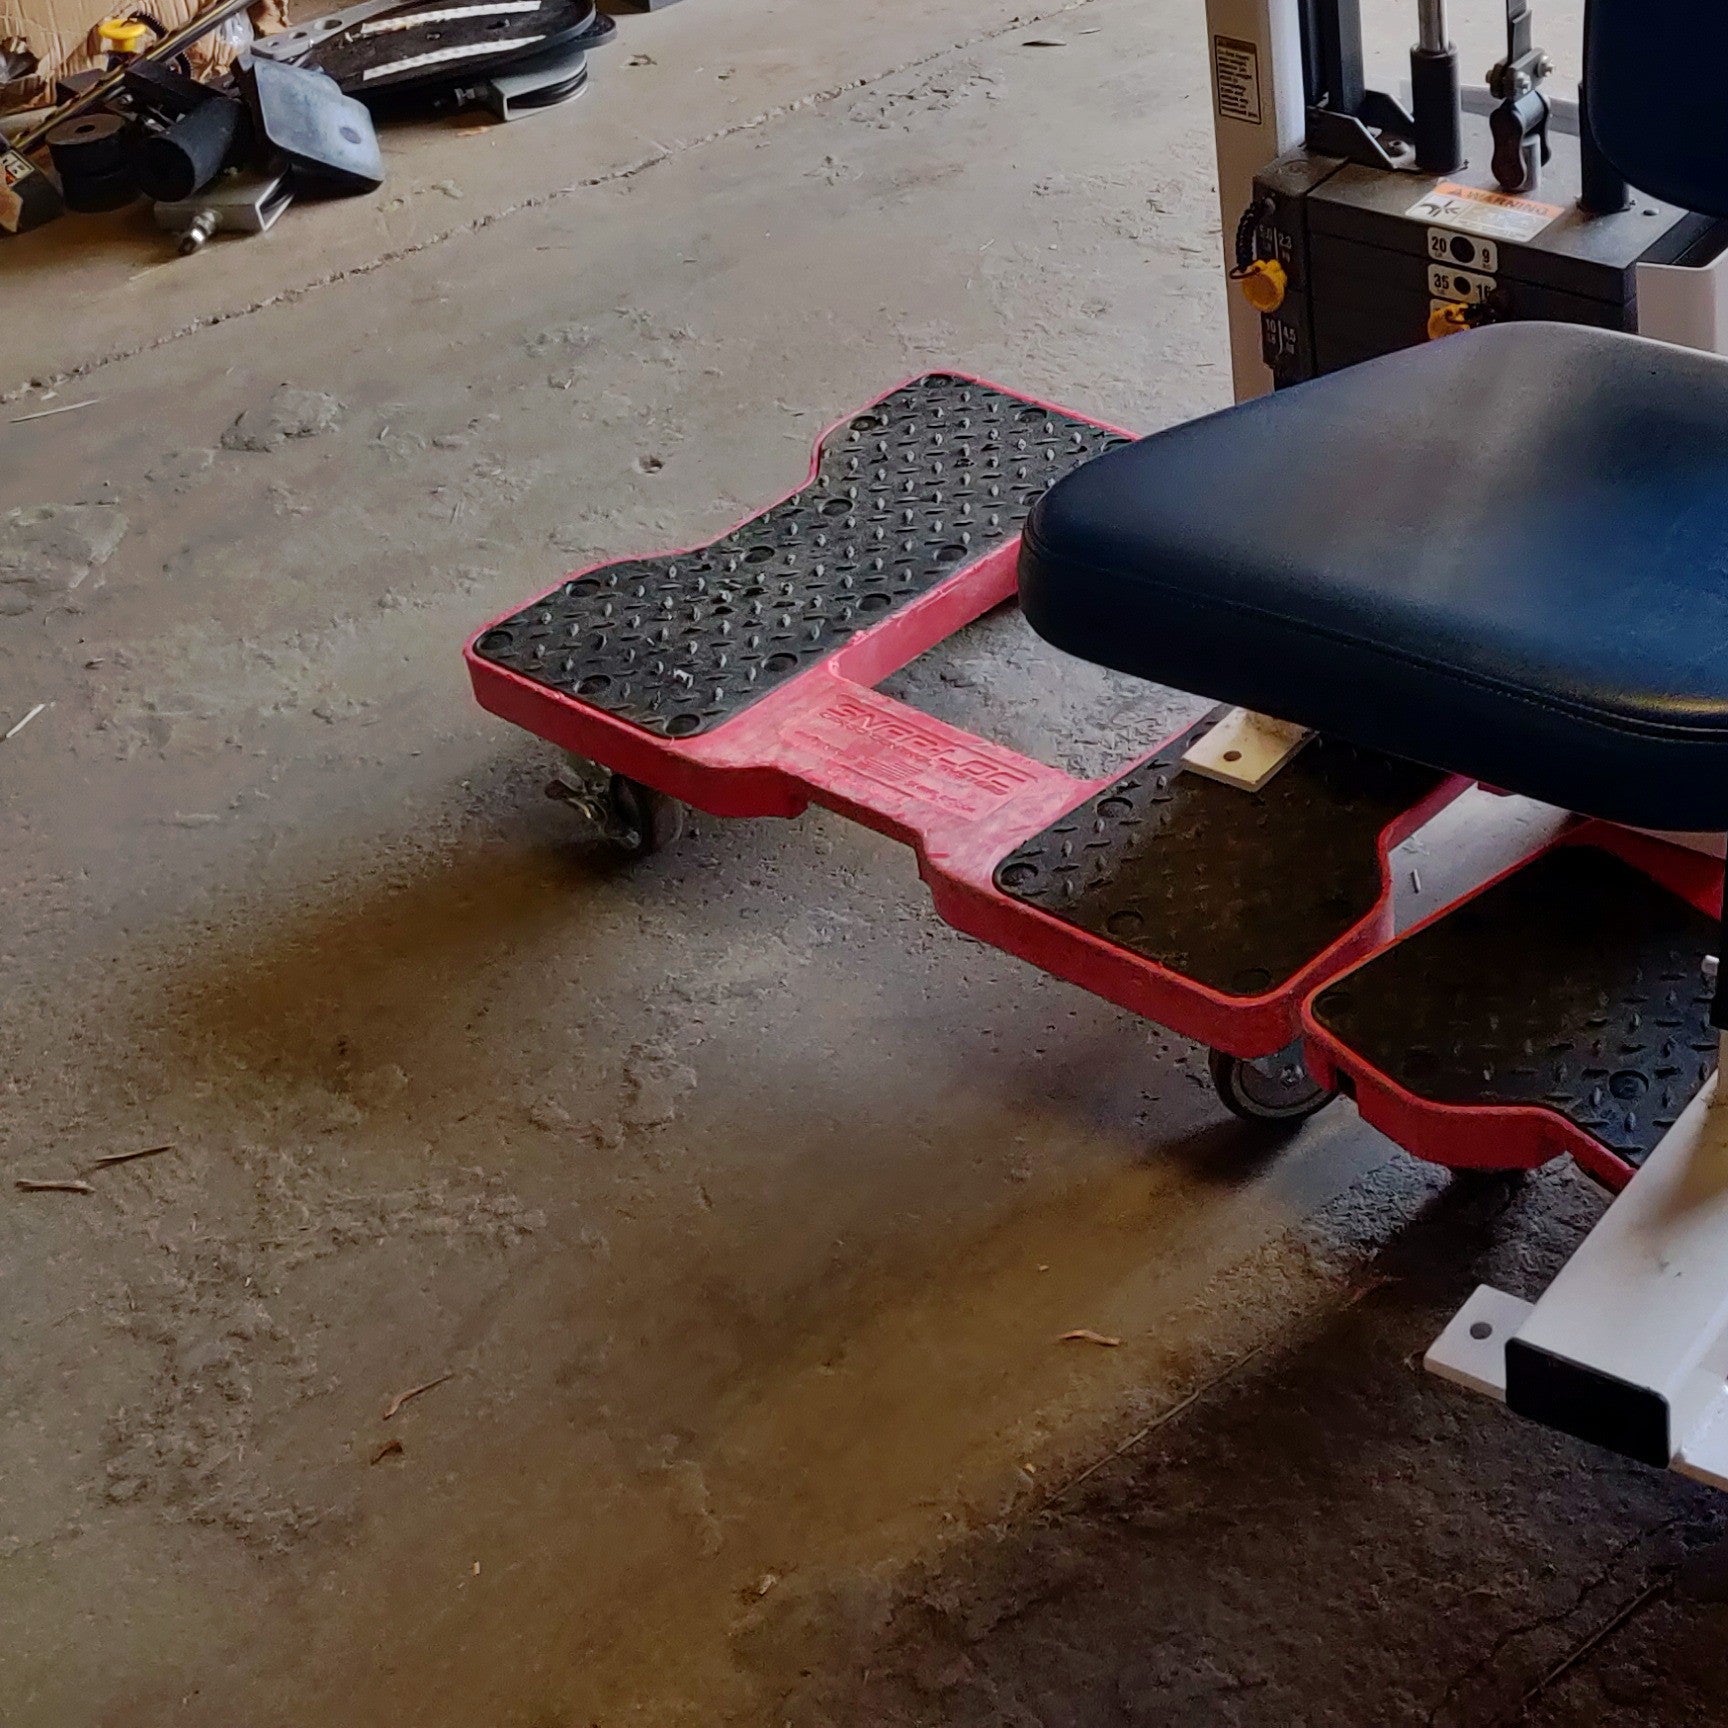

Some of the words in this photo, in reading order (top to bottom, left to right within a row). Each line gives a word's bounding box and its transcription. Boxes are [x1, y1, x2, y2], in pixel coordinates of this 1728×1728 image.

[1431, 236, 1447, 253] 20
[1481, 248, 1490, 263] 9
[1433, 273, 1450, 290] 35
